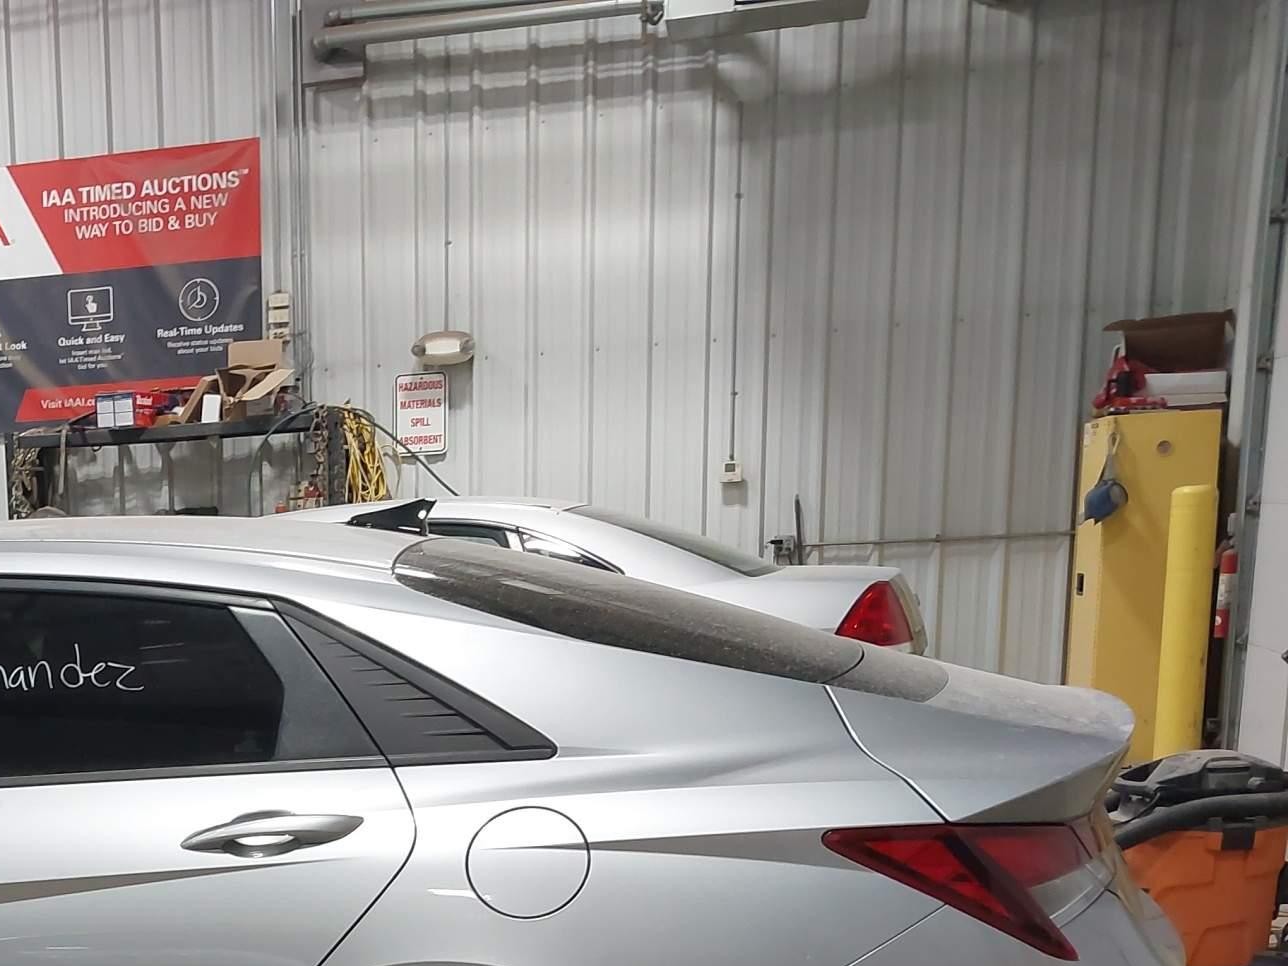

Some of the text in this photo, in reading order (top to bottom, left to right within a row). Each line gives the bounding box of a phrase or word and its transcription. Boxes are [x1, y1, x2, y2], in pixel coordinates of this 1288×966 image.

[42, 189, 76, 208] IAA
[79, 182, 136, 204] TIMED
[64, 192, 228, 222] INTRODUCING A NEW
[76, 212, 218, 240] WAY TO BID & BUY
[157, 324, 244, 338] Real-Time Updates
[4, 340, 28, 350] Look
[58, 334, 126, 346] Quick and Easy
[399, 380, 443, 392] HAZARDOUS
[41, 400, 62, 409] Visit
[400, 398, 442, 410] MATERIALS
[410, 417, 432, 427] SPILL
[400, 434, 442, 446] ABSORBENT
